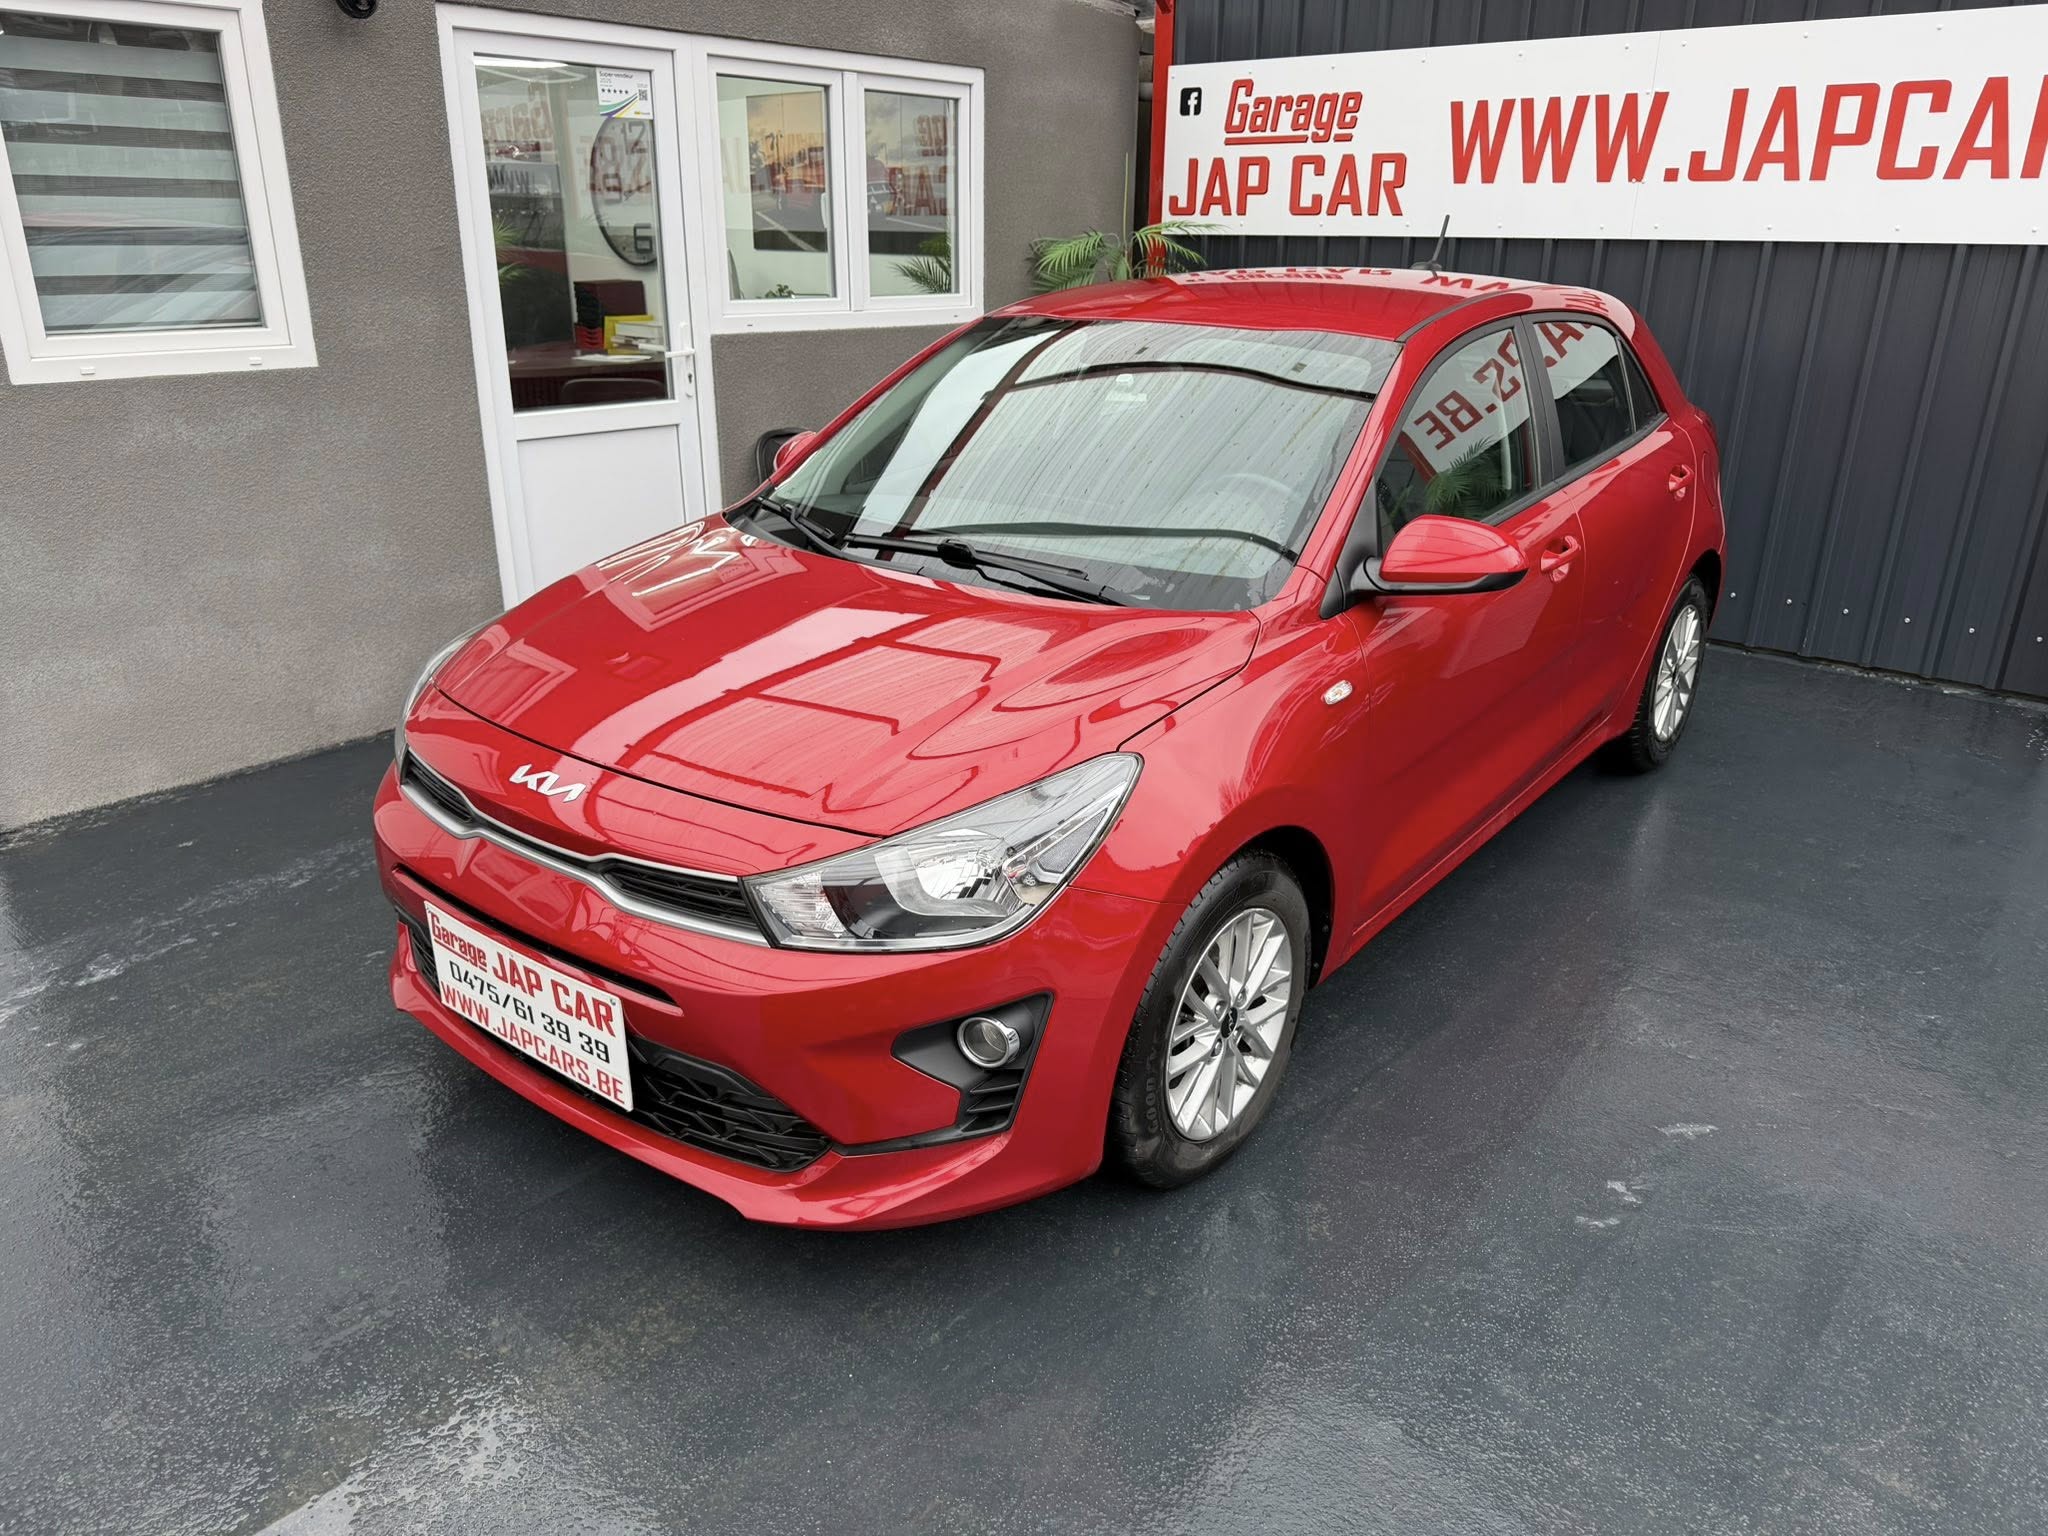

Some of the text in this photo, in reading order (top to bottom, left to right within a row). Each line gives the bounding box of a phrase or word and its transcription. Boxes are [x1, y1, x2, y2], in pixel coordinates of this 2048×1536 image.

[1224, 79, 1363, 143] Garage
[1168, 153, 1407, 216] JAP CAR
[430, 911, 616, 1038] Garage JAP CAR
[449, 960, 611, 1065] 0475/61 39 39
[440, 980, 626, 1105] WWW.JAPCARS.BE
